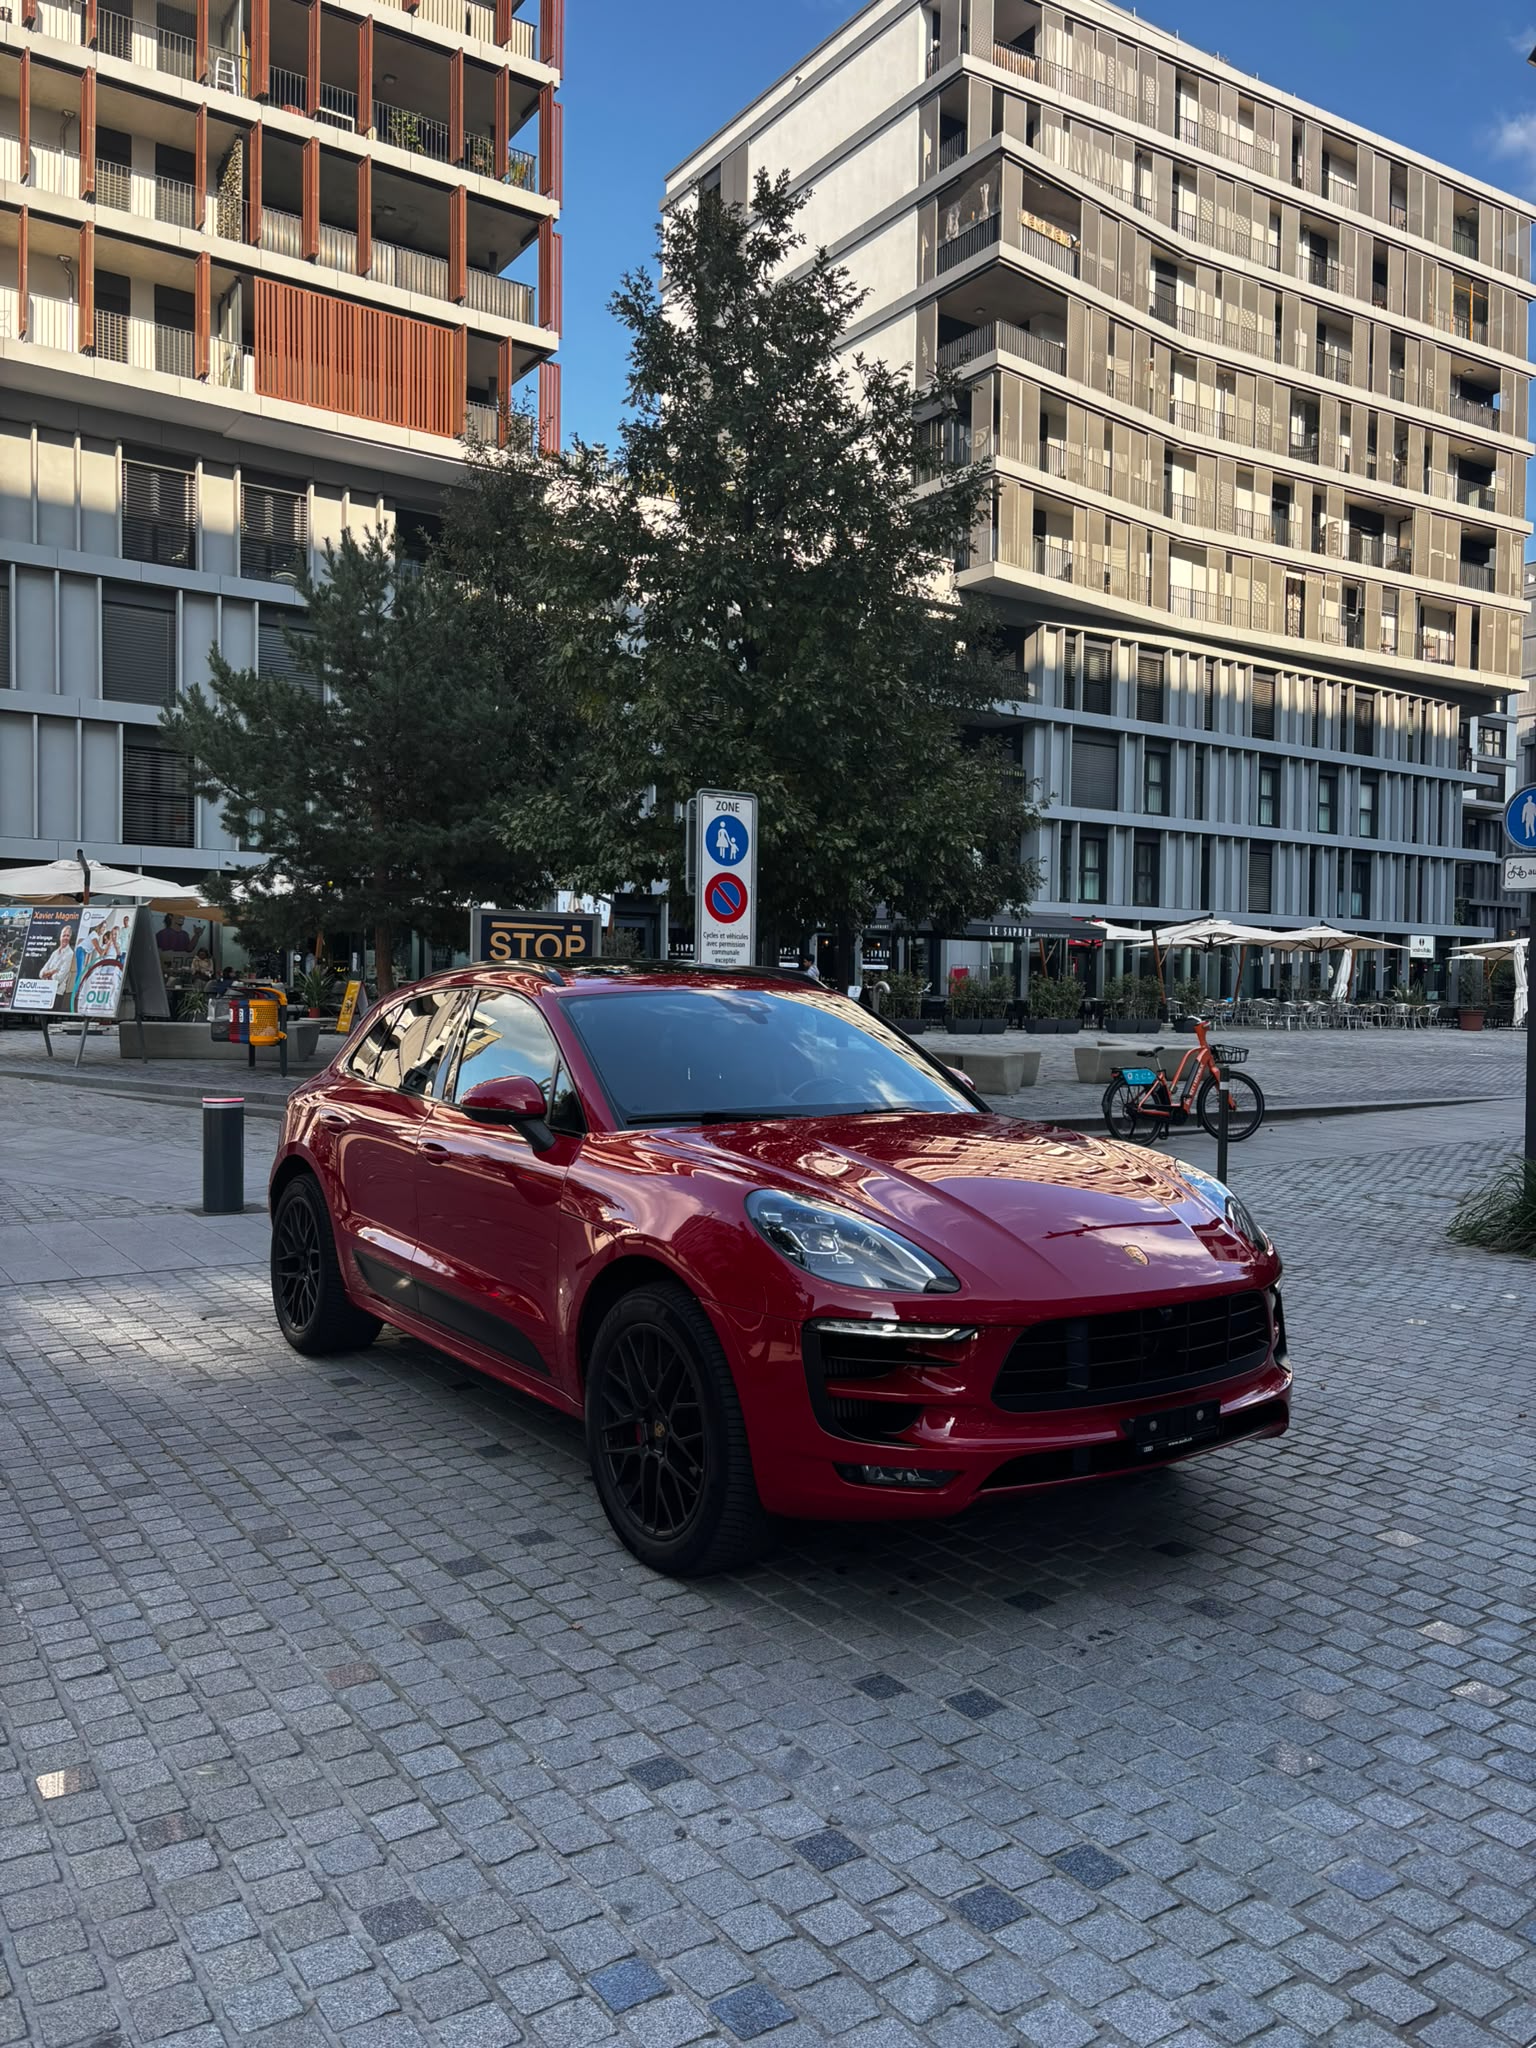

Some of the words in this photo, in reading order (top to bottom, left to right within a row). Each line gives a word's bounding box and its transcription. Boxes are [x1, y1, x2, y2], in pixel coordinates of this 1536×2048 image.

[716, 801, 740, 812] ZONE
[34, 911, 54, 920] Xavier
[56, 912, 80, 921] Magnin
[990, 926, 998, 936] LE
[1004, 928, 1032, 936] SAPHIR
[490, 931, 586, 960] STOP
[86, 991, 110, 1003] OUI
